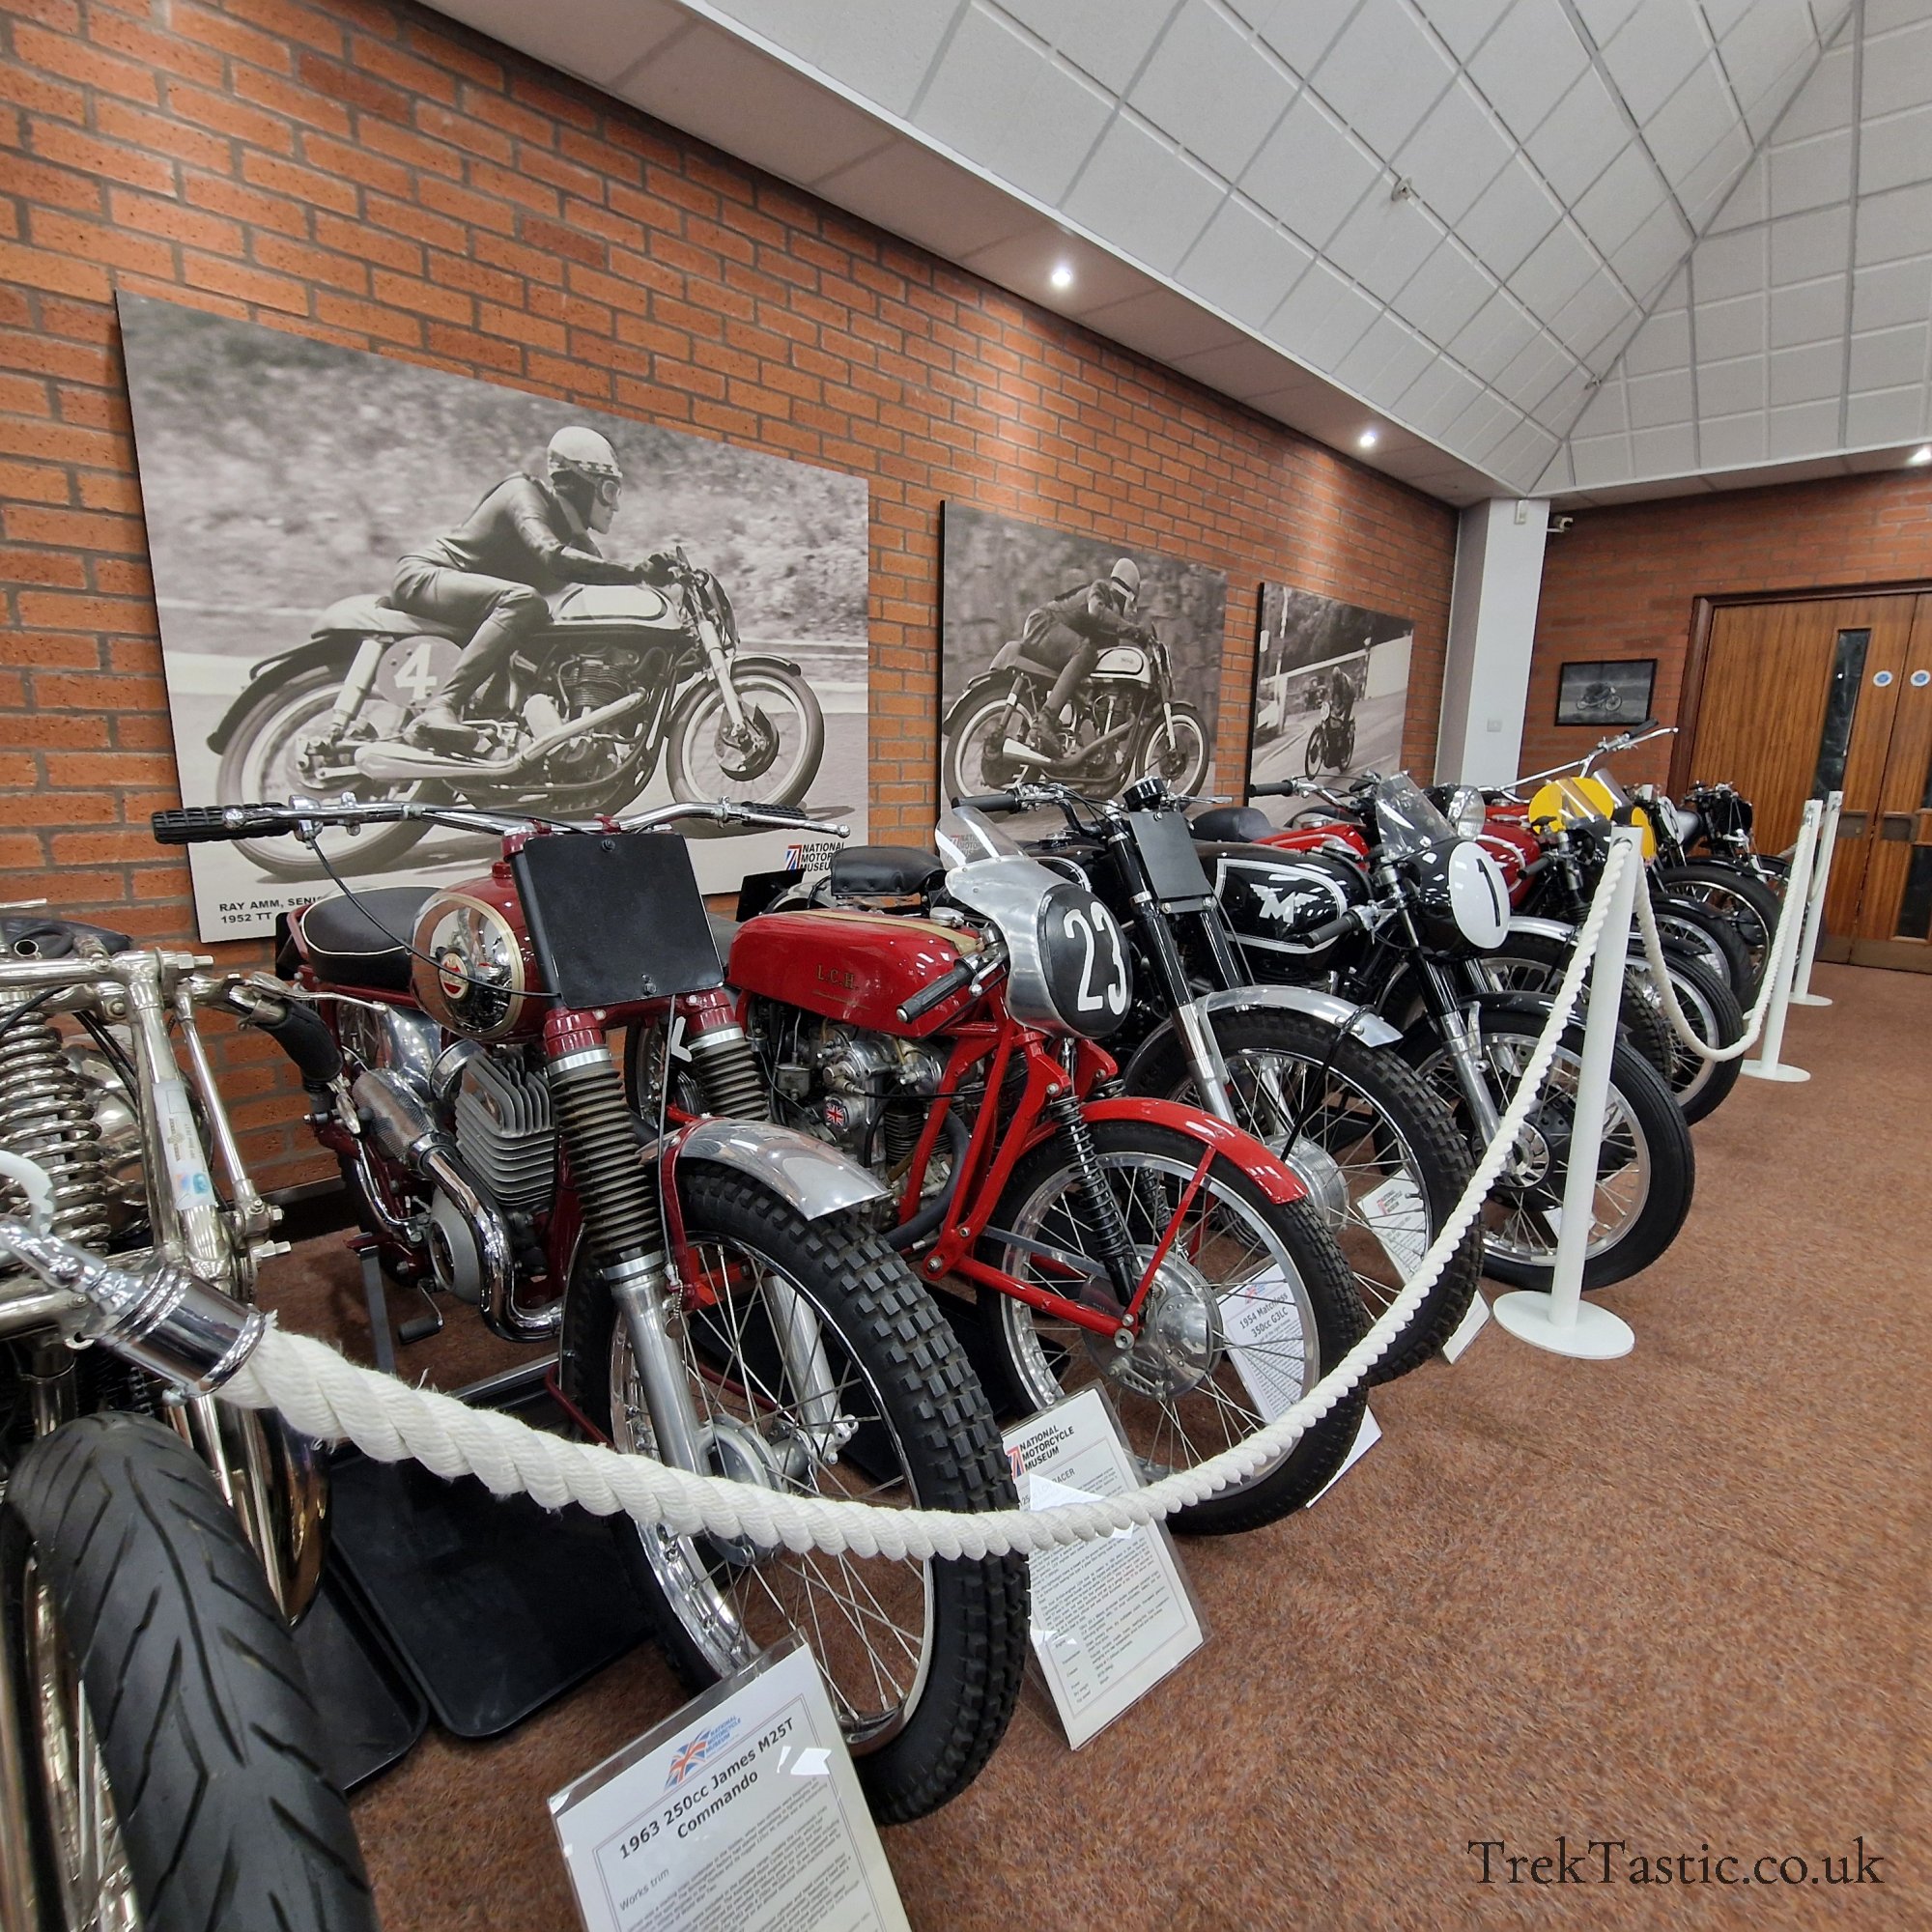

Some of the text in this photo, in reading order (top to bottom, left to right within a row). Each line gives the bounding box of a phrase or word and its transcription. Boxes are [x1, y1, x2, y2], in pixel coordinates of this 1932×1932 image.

[393, 642, 438, 700] 4
[219, 902, 244, 912] RAY
[250, 898, 284, 910] AMM,
[1476, 858, 1501, 927] 1
[221, 912, 272, 923] 1952 TT
[1064, 901, 1127, 1015] 23
[1239, 1312, 1258, 1330] 1954
[1251, 1306, 1289, 1338] 350cc G3LC
[1020, 1425, 1060, 1451] NATIONAL
[1022, 1426, 1074, 1462] MOTORCYCLE
[1024, 1446, 1060, 1471] MUSEUM
[618, 1820, 661, 1860] 1963
[663, 1786, 710, 1826] 250cc
[711, 1750, 756, 1790] James
[757, 1717, 795, 1756] M25T
[676, 1771, 758, 1839] Commando
[619, 1884, 649, 1911] Works
[650, 1868, 669, 1887] trim
